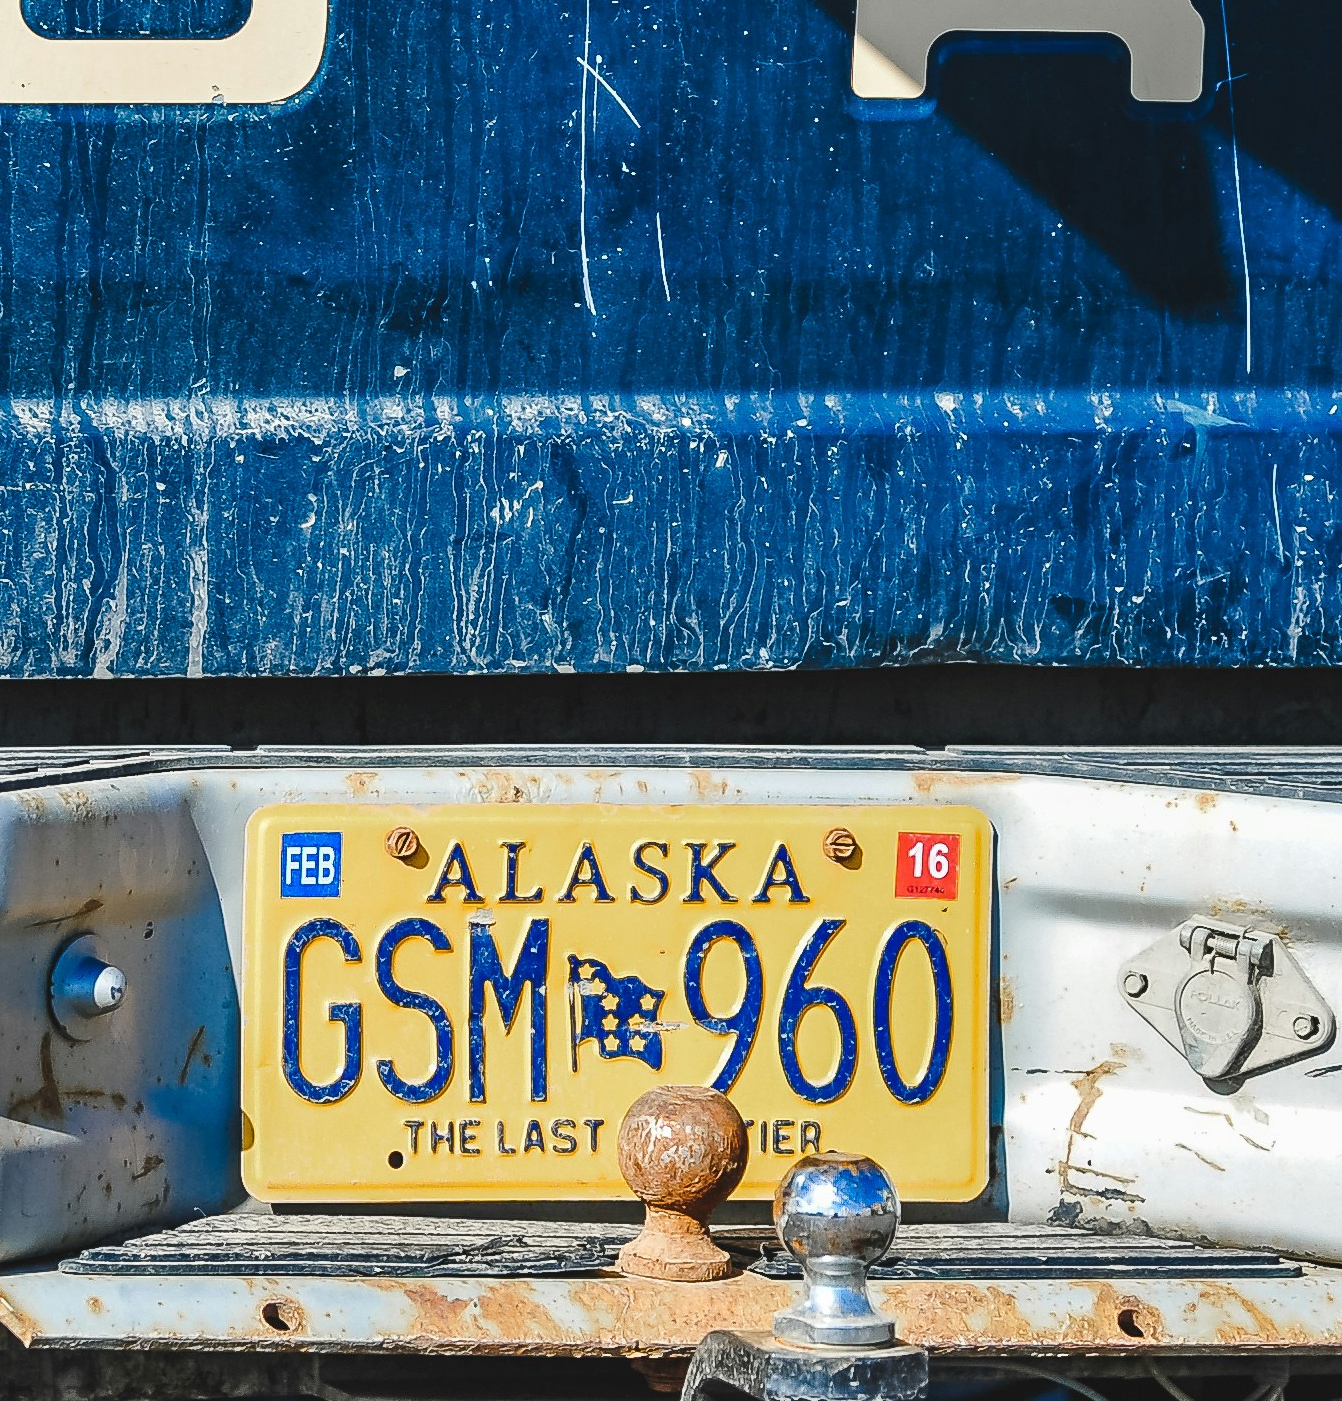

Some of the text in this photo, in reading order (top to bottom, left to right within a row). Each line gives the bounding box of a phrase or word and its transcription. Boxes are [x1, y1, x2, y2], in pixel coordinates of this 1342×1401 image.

[285, 846, 336, 886] FEB
[425, 840, 811, 904] ALASKA
[908, 841, 950, 879] 16
[281, 918, 953, 1106] GSM 960
[403, 1119, 605, 1155] THE LAST
